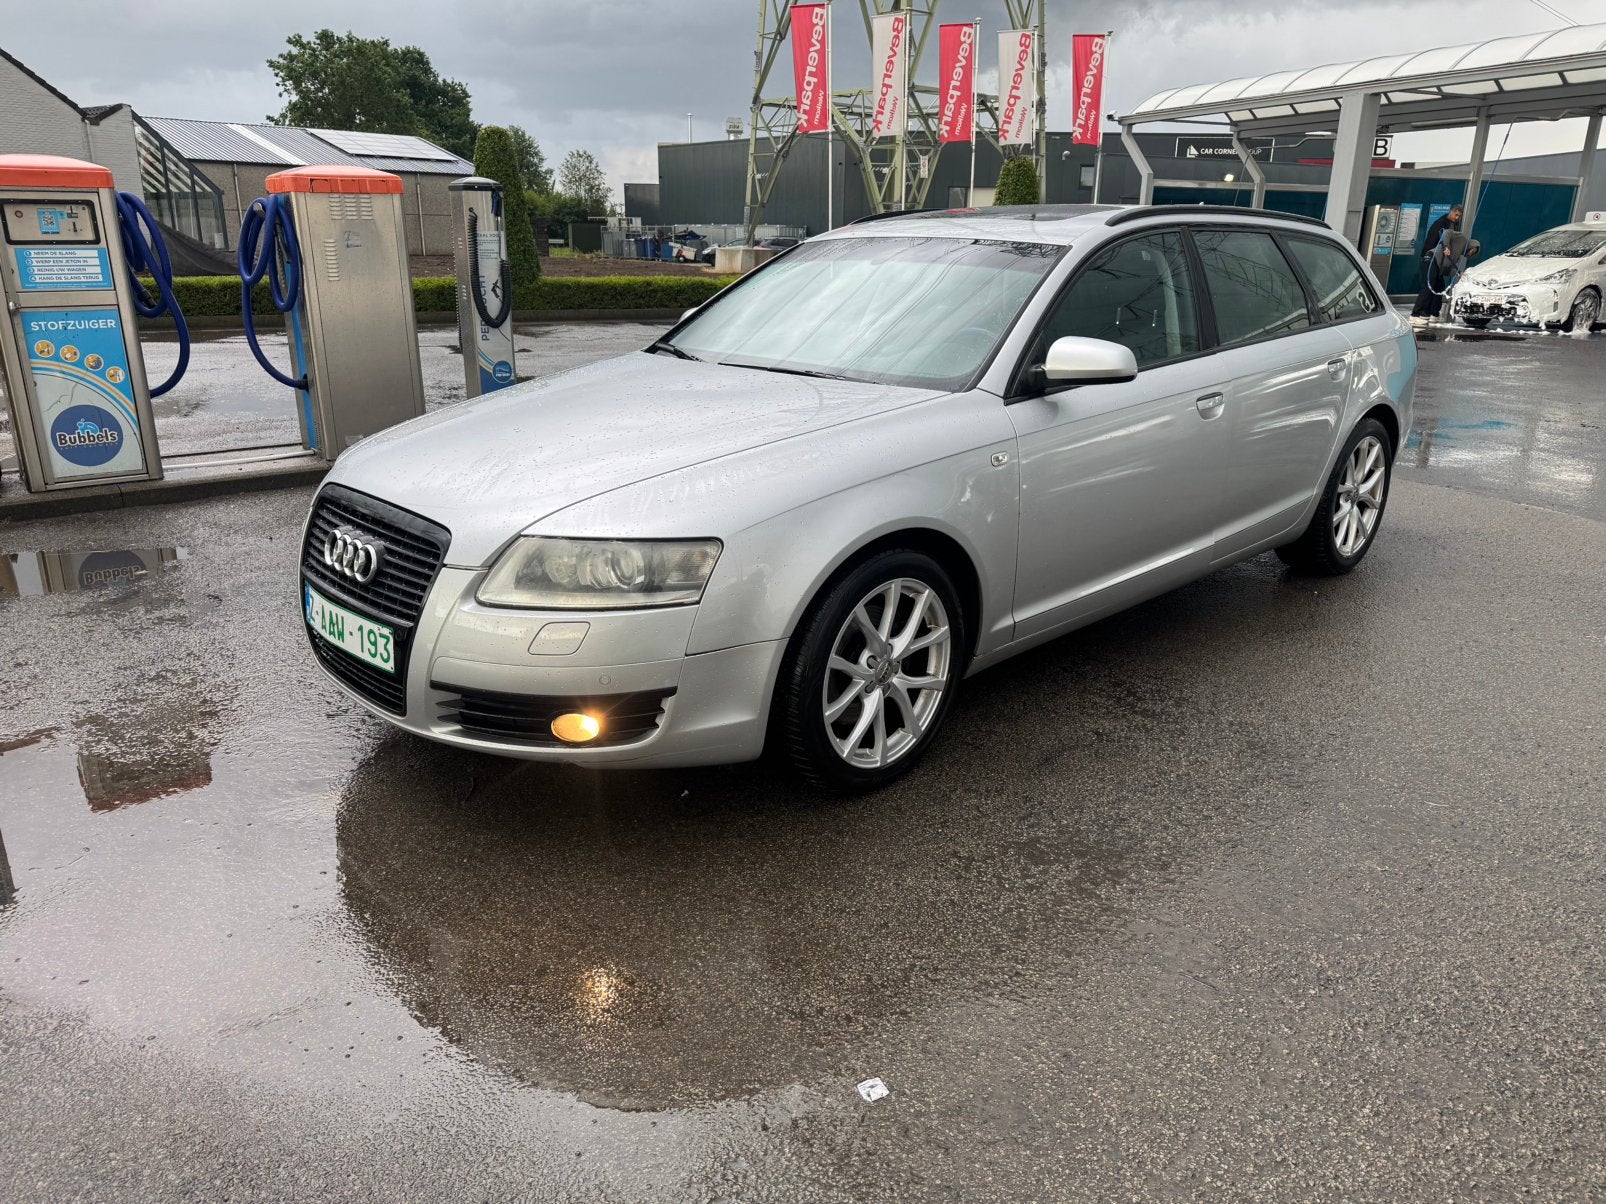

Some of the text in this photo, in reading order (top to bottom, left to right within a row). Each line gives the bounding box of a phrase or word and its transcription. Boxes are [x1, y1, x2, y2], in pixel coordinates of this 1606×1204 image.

[1373, 138, 1388, 156] B
[31, 319, 116, 331] STOFZUIGER
[56, 429, 118, 447] Bubbels
